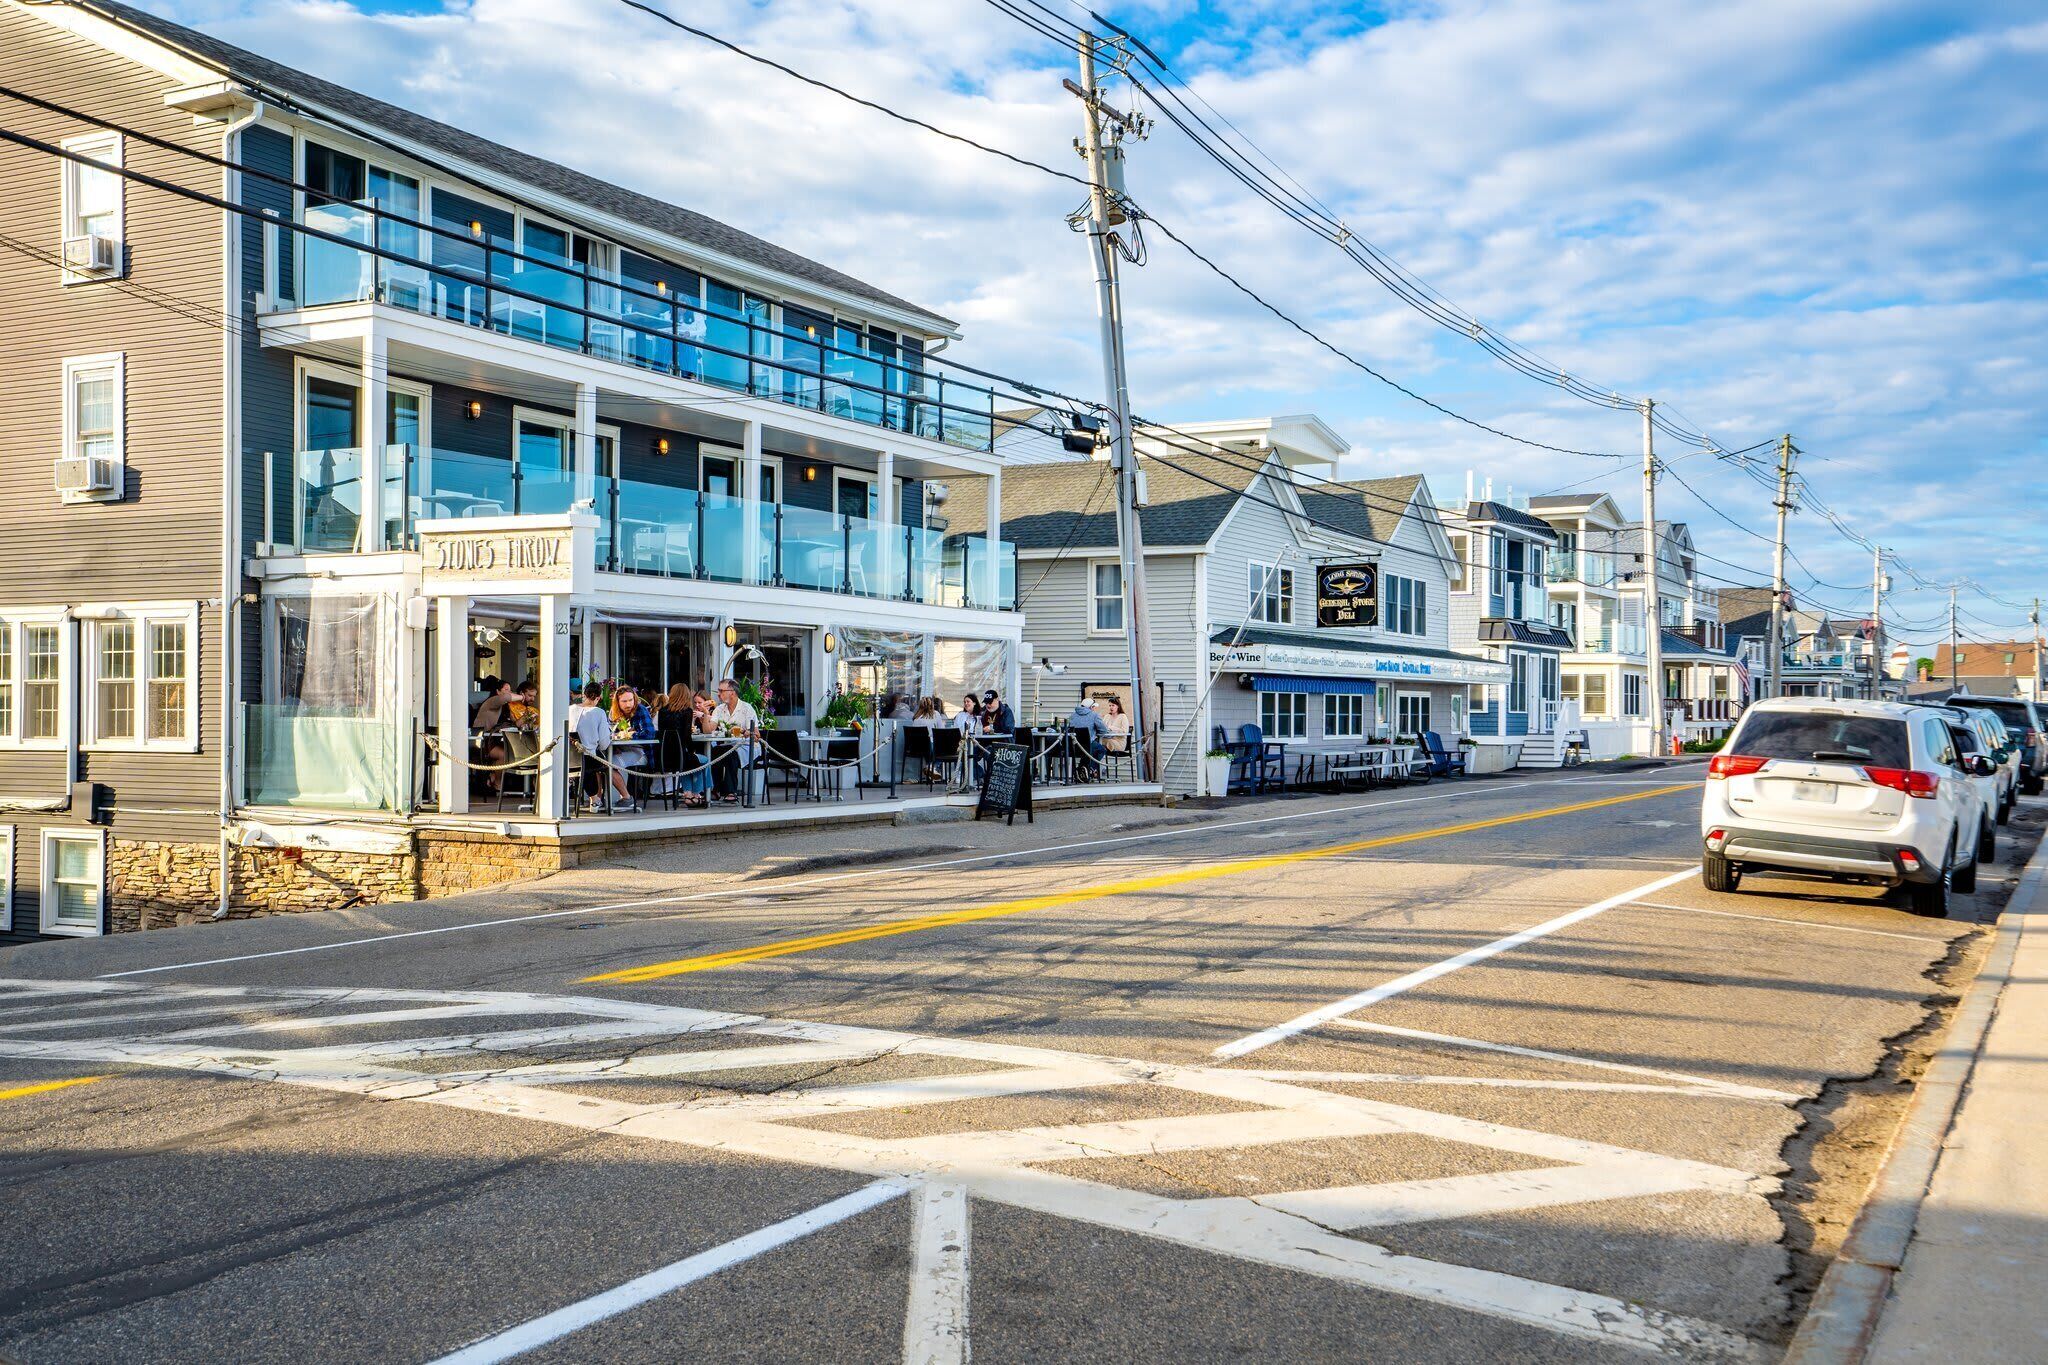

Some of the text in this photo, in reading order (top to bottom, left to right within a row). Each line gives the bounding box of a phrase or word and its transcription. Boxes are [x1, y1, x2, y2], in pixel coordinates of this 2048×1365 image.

[437, 537, 560, 570] STONES THROW
[1352, 597, 1375, 608] STORE
[1336, 610, 1355, 621] DELI
[555, 622, 568, 635] 123
[1236, 652, 1261, 662] Wine
